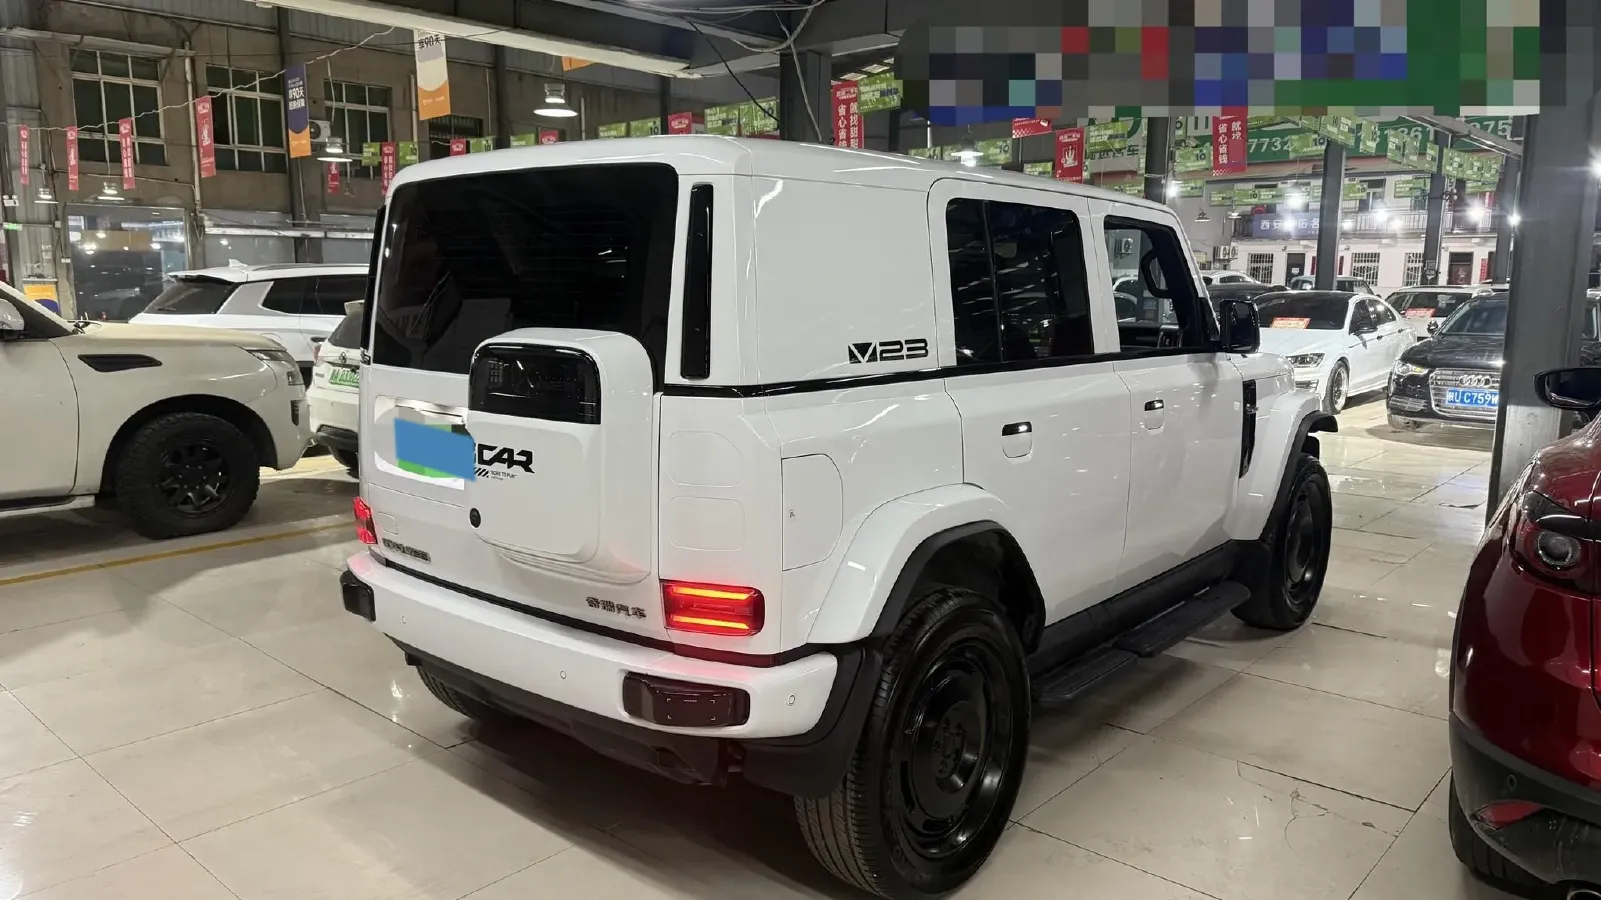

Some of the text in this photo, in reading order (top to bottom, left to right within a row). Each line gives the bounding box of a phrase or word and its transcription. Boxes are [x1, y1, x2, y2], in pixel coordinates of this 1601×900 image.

[1218, 123, 1229, 165] 省心省钱
[848, 338, 929, 365] V23
[473, 442, 536, 475] CAR
[585, 596, 647, 619] 奇瑞汽车
